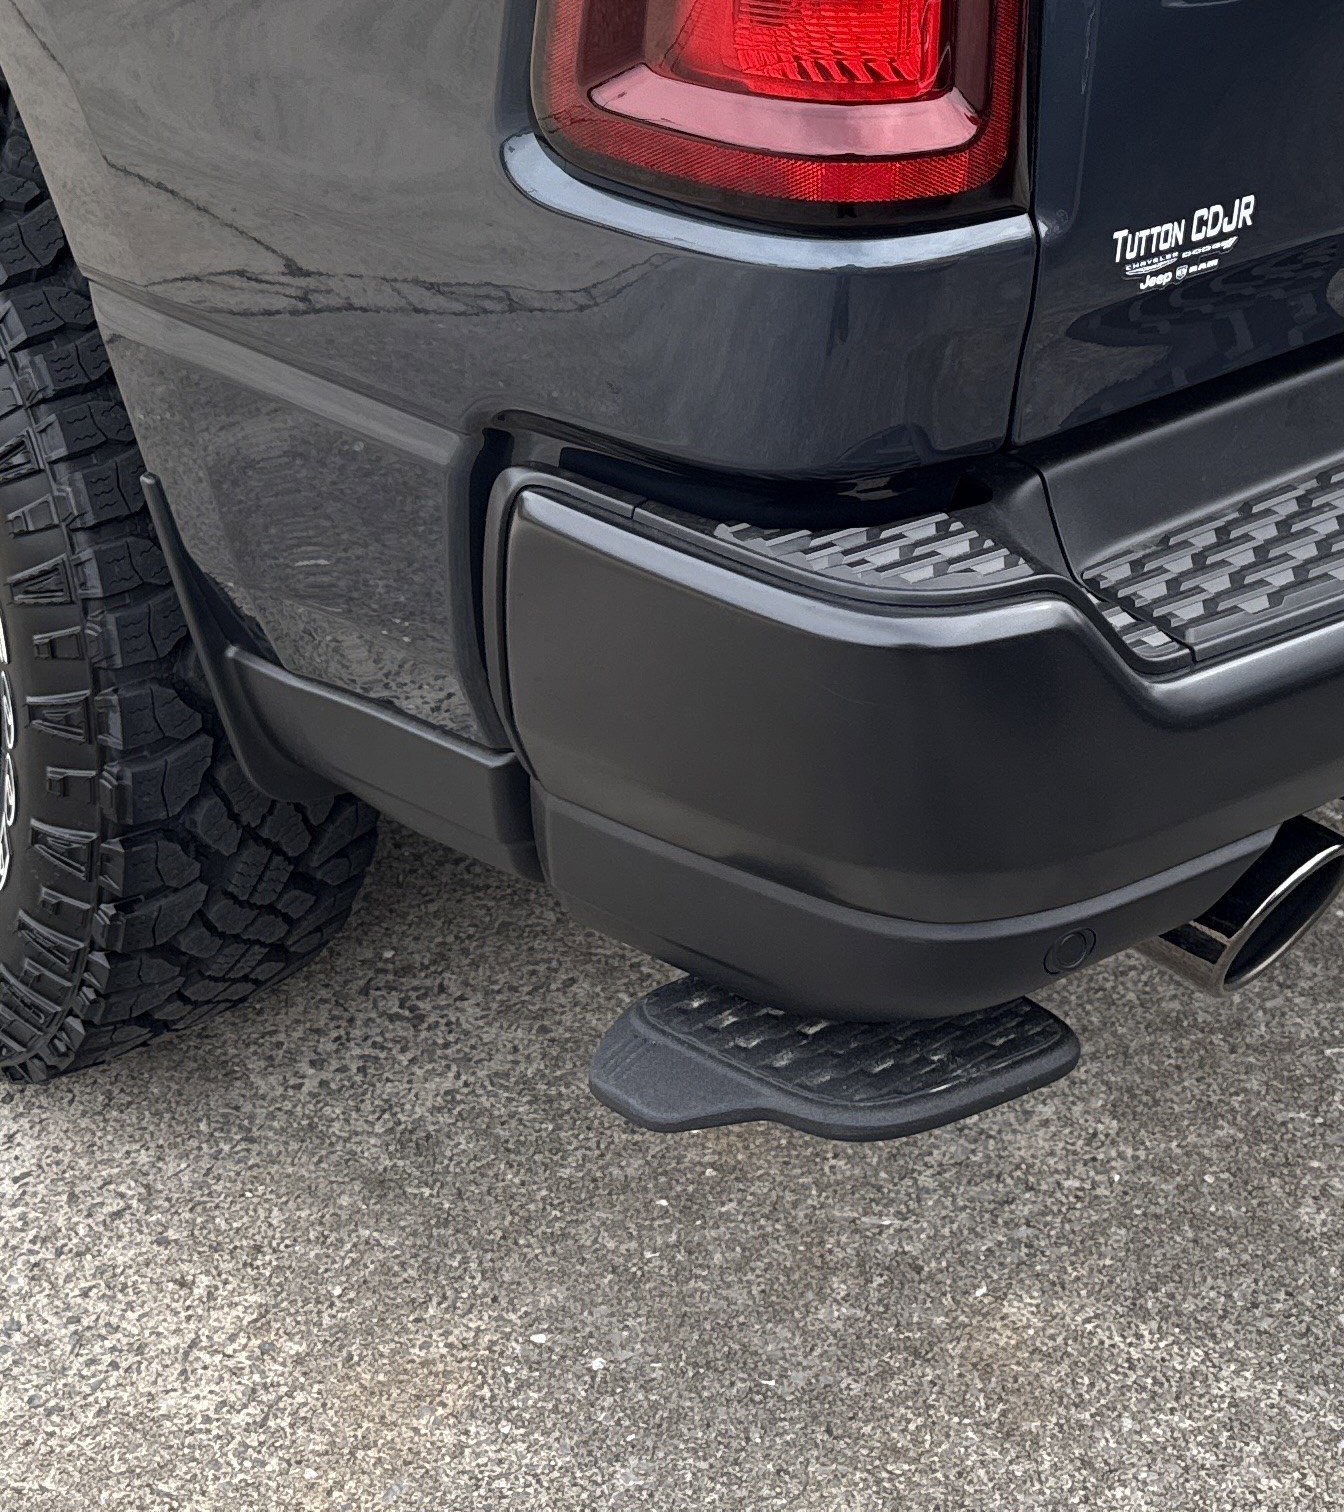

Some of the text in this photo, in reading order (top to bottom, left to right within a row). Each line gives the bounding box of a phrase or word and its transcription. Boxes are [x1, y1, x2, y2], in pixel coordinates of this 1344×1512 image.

[1191, 194, 1256, 242] CDJR
[1139, 258, 1219, 290] Jeep RAM
